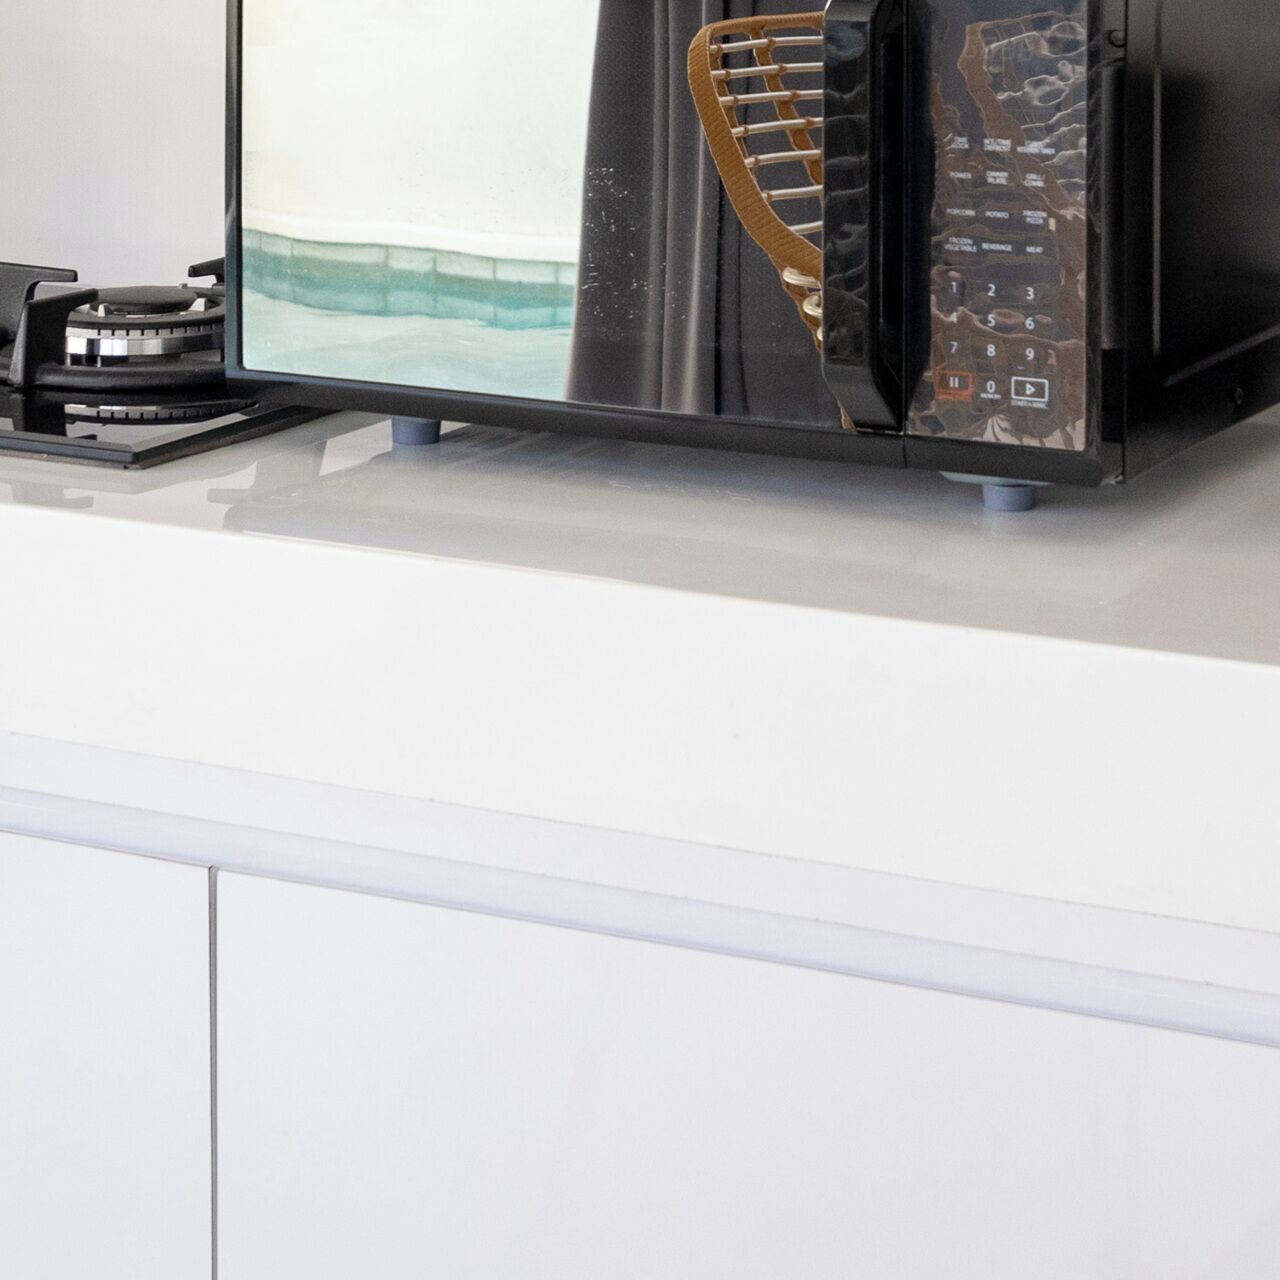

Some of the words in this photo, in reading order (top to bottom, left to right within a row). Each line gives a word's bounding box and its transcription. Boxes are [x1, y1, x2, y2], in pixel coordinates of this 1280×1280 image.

[949, 171, 972, 179] POWER
[946, 208, 976, 216] POPCORN
[985, 211, 1010, 219] POTATO
[981, 242, 1013, 252] BEVERAGE
[951, 281, 957, 293] 1
[987, 283, 996, 297] 2
[1025, 286, 1034, 300] 3
[949, 311, 958, 323] 4
[987, 314, 996, 327] 5
[1025, 317, 1035, 330] 6
[950, 341, 958, 353] 7
[986, 343, 996, 357] 8
[1025, 347, 1035, 360] 9
[986, 380, 996, 393] 0
